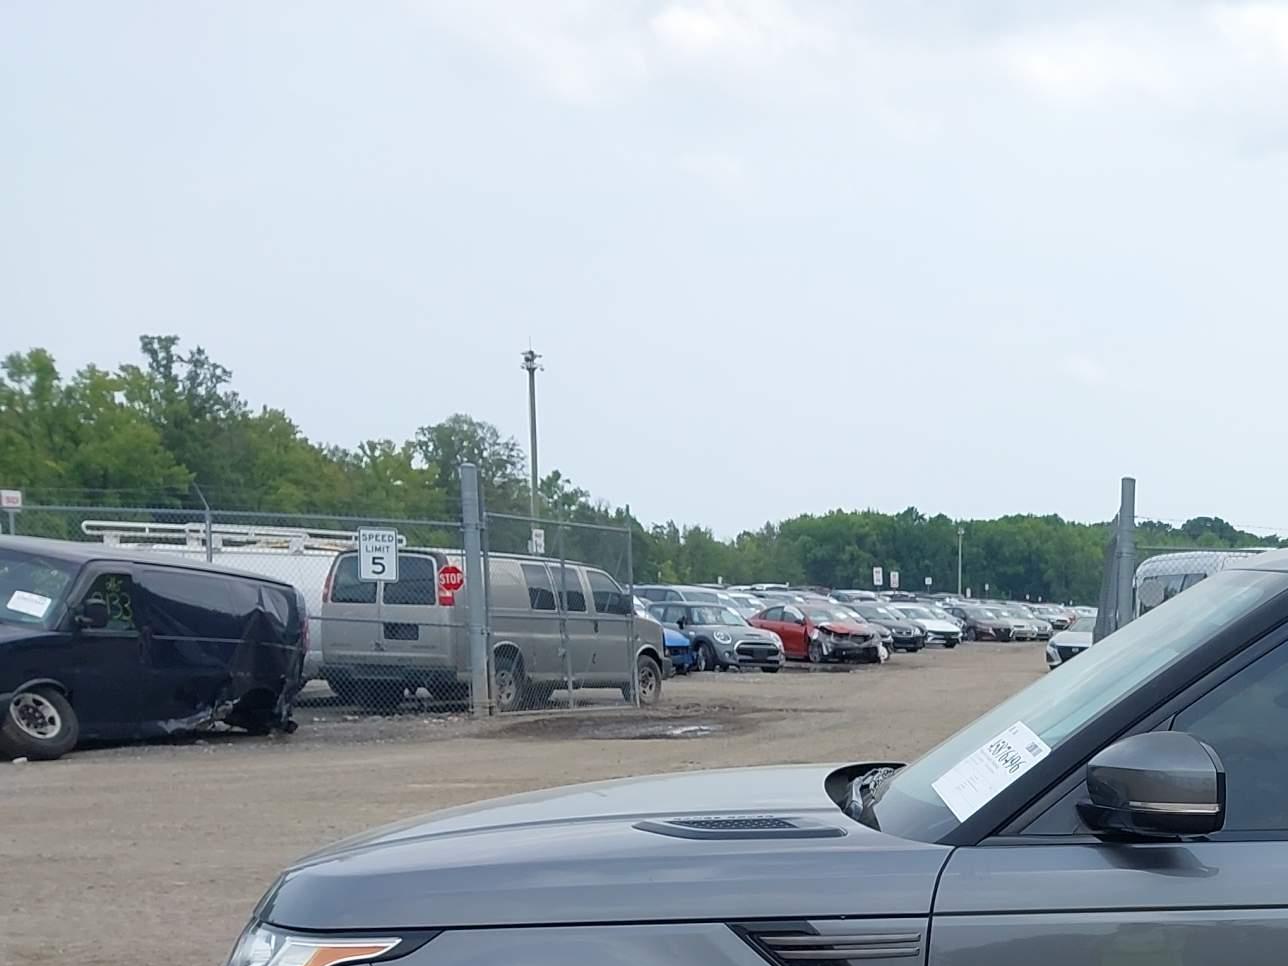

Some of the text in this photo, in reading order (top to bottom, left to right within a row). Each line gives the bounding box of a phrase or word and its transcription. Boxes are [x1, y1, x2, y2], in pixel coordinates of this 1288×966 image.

[362, 534, 394, 543] SPEED
[366, 545, 390, 553] LIMIT
[371, 556, 386, 575] 5
[439, 573, 463, 585] STOP
[989, 739, 1027, 774] 45876496
